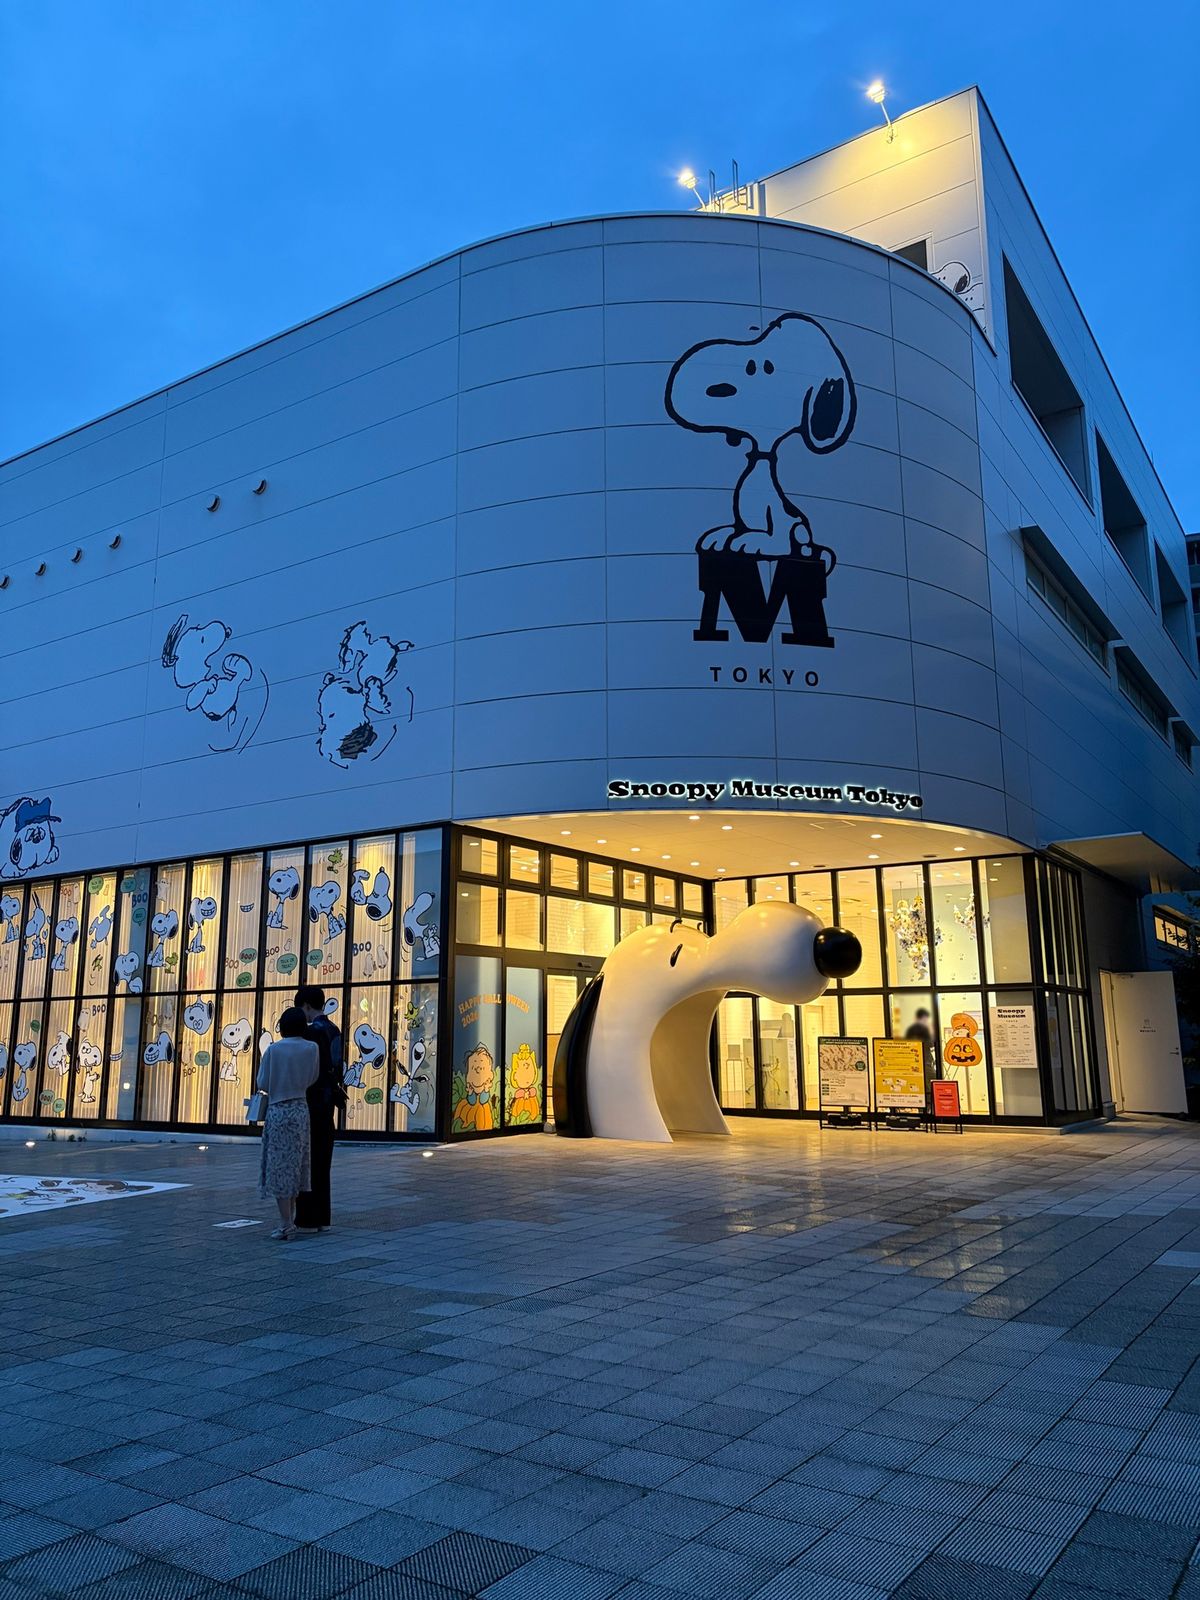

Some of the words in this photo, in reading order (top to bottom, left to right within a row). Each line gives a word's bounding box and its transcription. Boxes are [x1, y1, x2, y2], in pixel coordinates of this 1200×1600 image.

[710, 666, 819, 687] TOKYO
[608, 780, 725, 801] Snoopy
[731, 780, 843, 800] Museum
[847, 785, 923, 810] Tokyo
[265, 946, 280, 958] BOO
[353, 941, 372, 957] BOO
[322, 962, 341, 976] BOO
[92, 1004, 106, 1017] BOO
[183, 1066, 197, 1077] BOO
